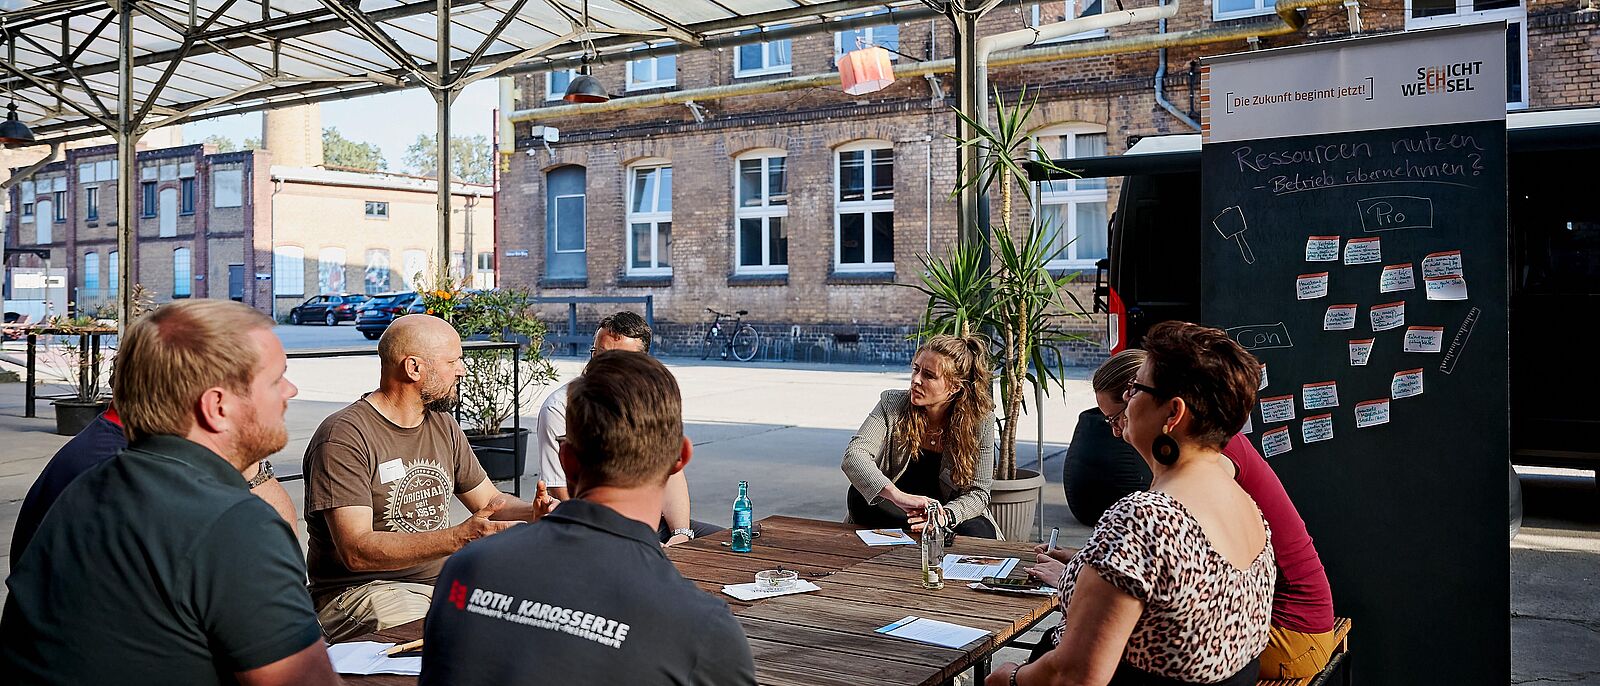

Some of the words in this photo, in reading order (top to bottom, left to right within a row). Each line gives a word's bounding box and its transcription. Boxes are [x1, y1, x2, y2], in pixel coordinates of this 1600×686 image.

[1252, 92, 1292, 106] Zukunft
[1294, 87, 1335, 102] beginnt
[1232, 141, 1371, 173] Ressourcen
[1391, 130, 1485, 154] nutzen
[1268, 171, 1335, 194] Betrieb
[1366, 201, 1406, 226] Pro
[1236, 329, 1281, 349] Con
[403, 485, 443, 505] ORIGINAL
[415, 499, 429, 509] seit
[415, 505, 437, 518] 1965
[469, 588, 514, 612] ROTH
[517, 599, 630, 642] KAROSSERIE
